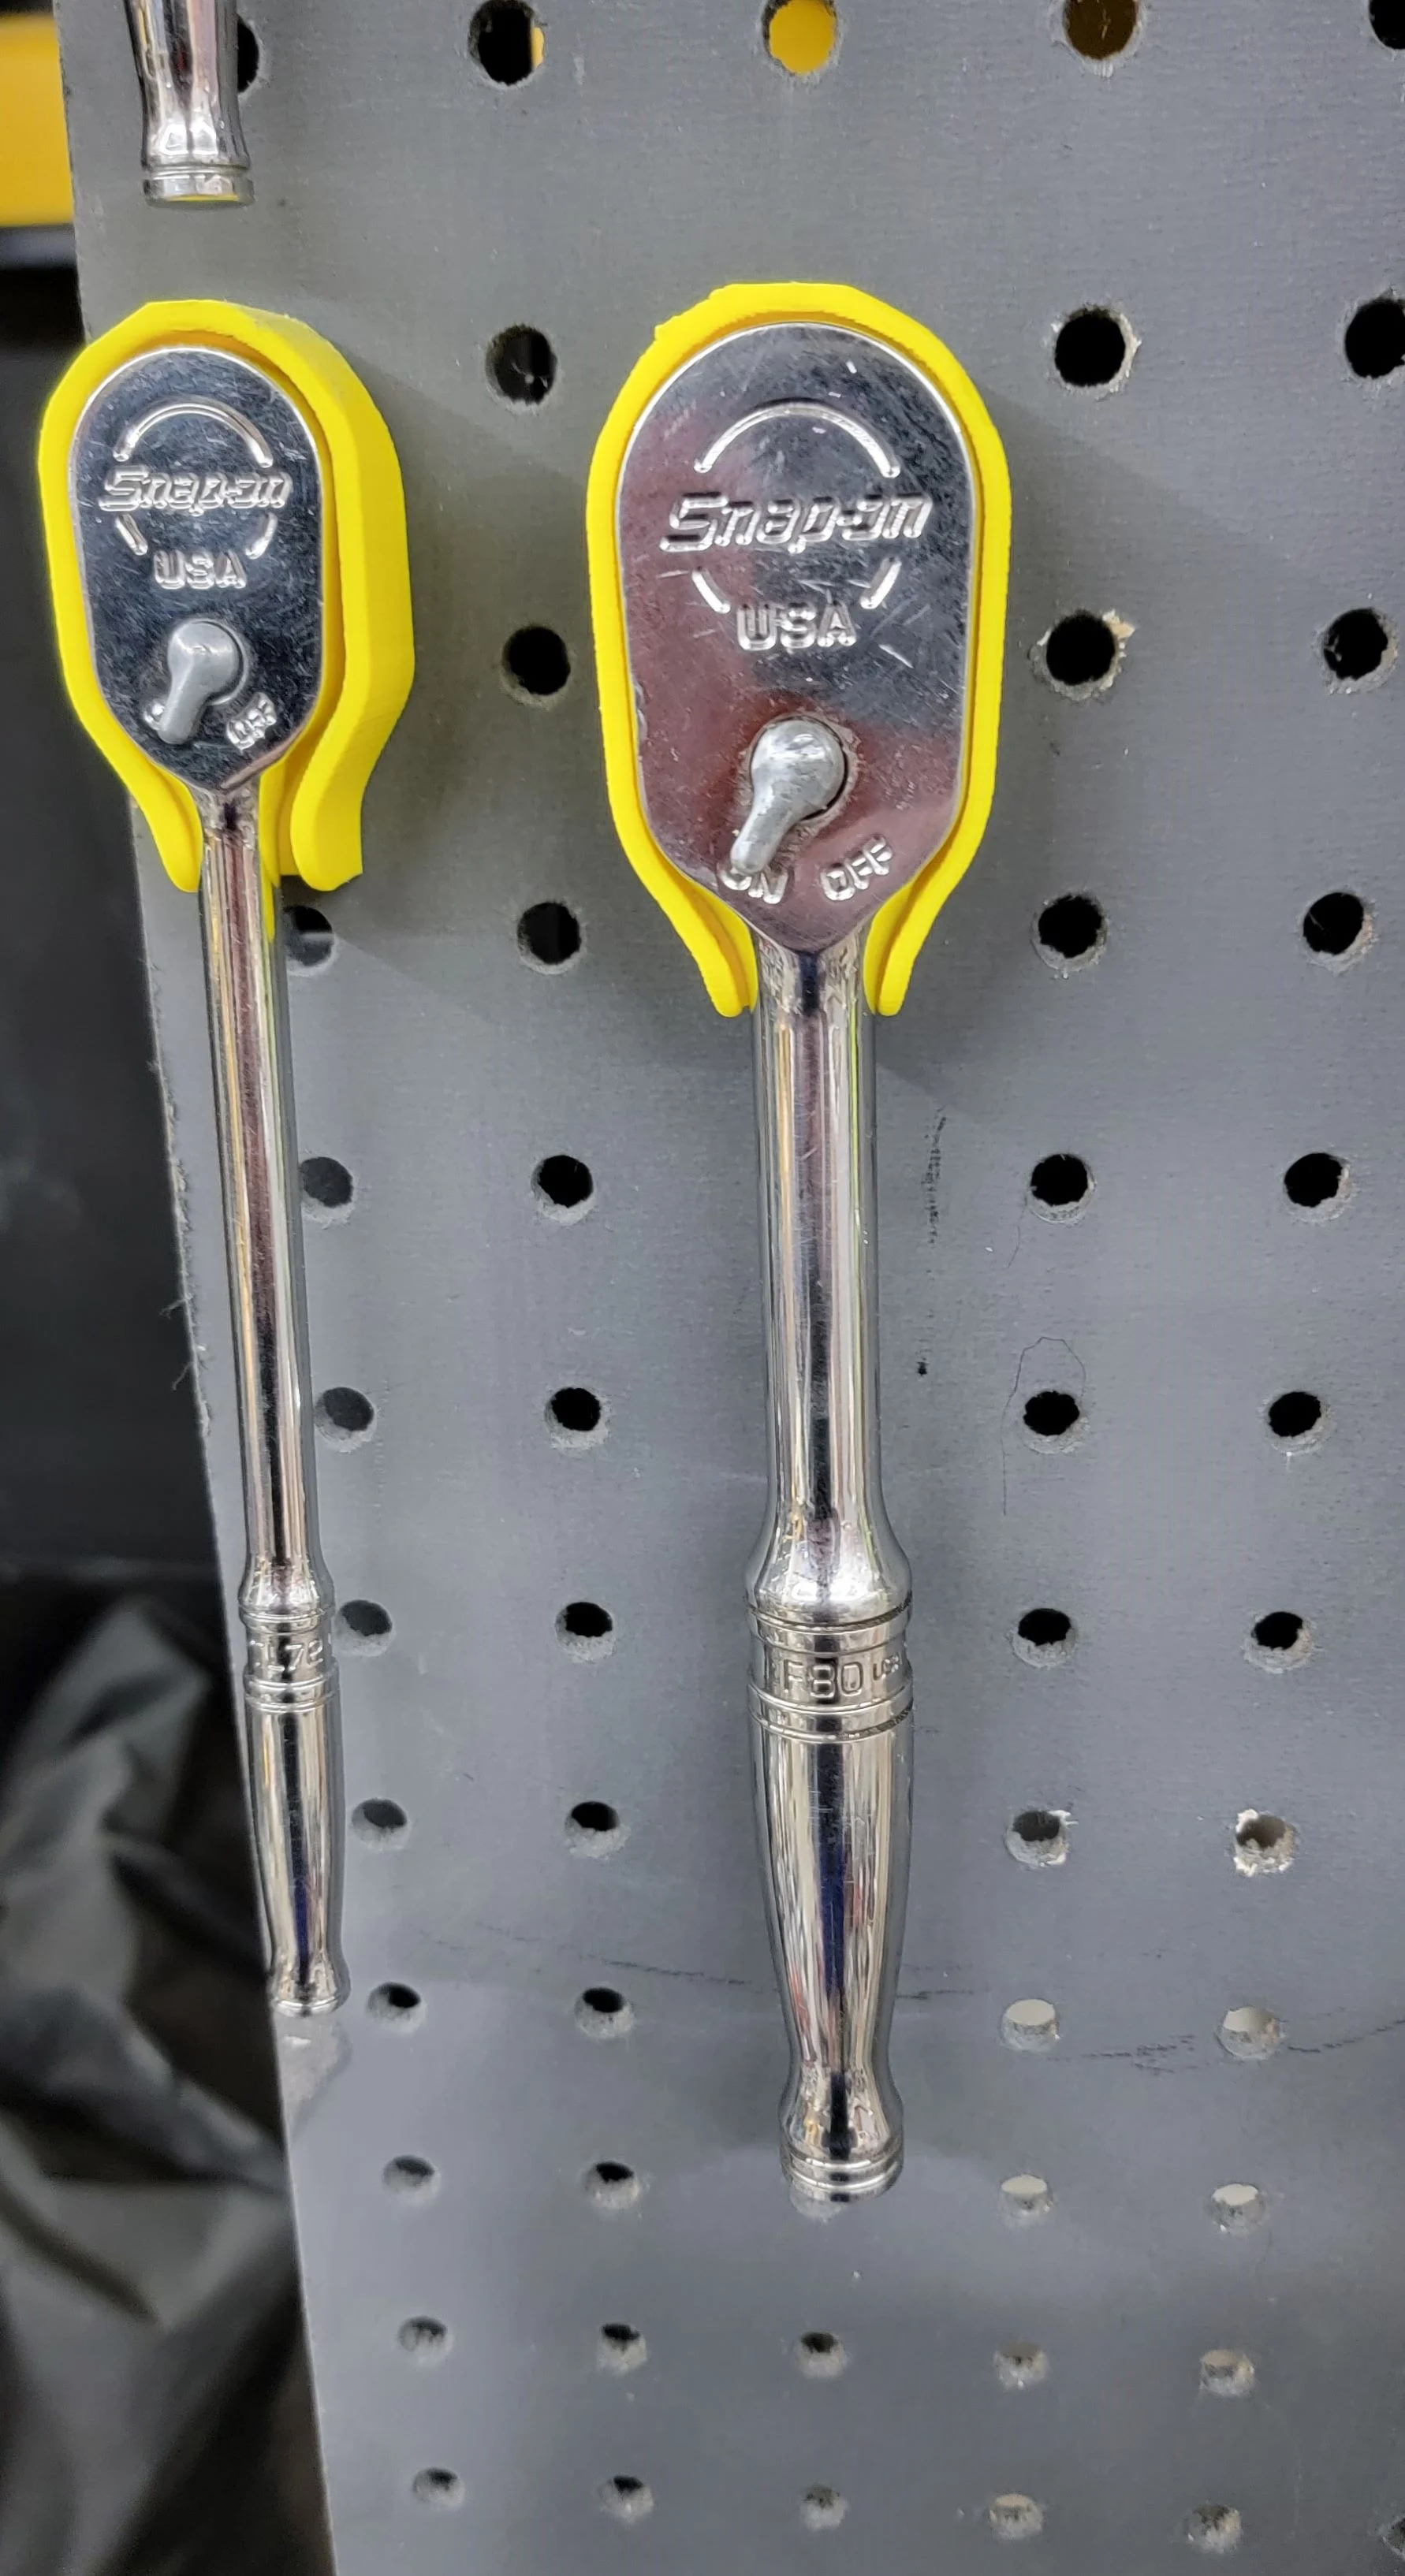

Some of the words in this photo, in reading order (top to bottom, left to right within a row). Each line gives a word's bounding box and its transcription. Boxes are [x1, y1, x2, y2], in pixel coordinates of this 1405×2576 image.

[99, 466, 292, 516] Snap-on
[660, 492, 932, 553] Snap-on
[154, 551, 247, 590] USA
[736, 602, 857, 651] USA
[226, 692, 277, 749] OFF
[820, 835, 893, 901] OFF
[783, 1658, 864, 1699] F80
